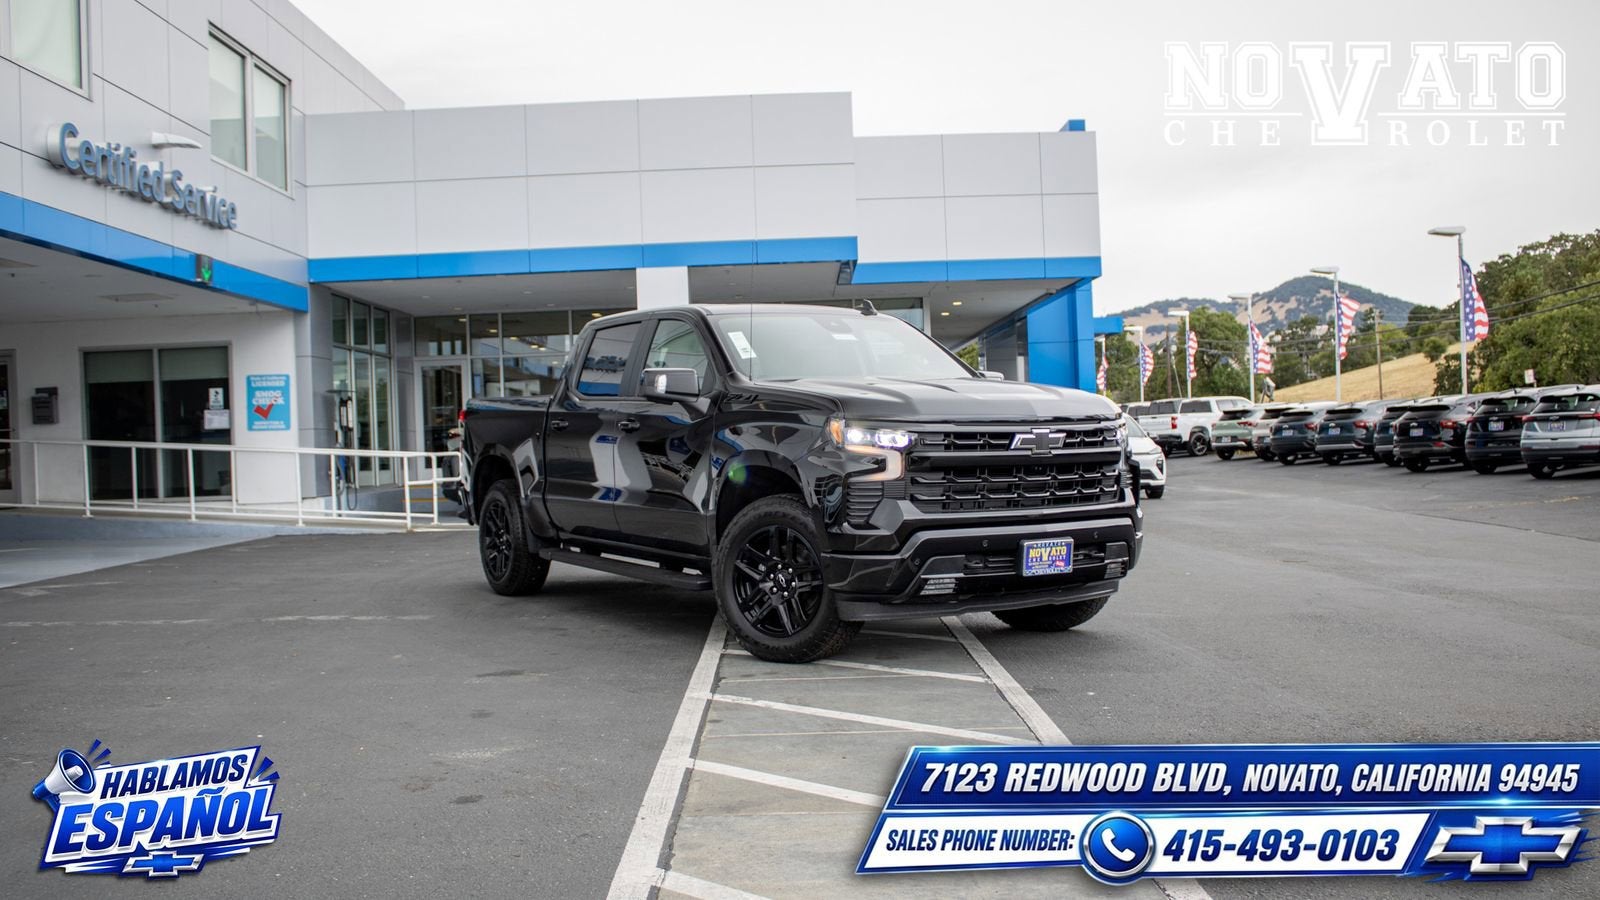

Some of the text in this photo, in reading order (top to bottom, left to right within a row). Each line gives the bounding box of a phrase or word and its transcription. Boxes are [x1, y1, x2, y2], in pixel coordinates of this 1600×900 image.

[58, 122, 237, 230] Certified Service
[255, 390, 282, 398] SMOG
[1029, 546, 1067, 561] NOVATO
